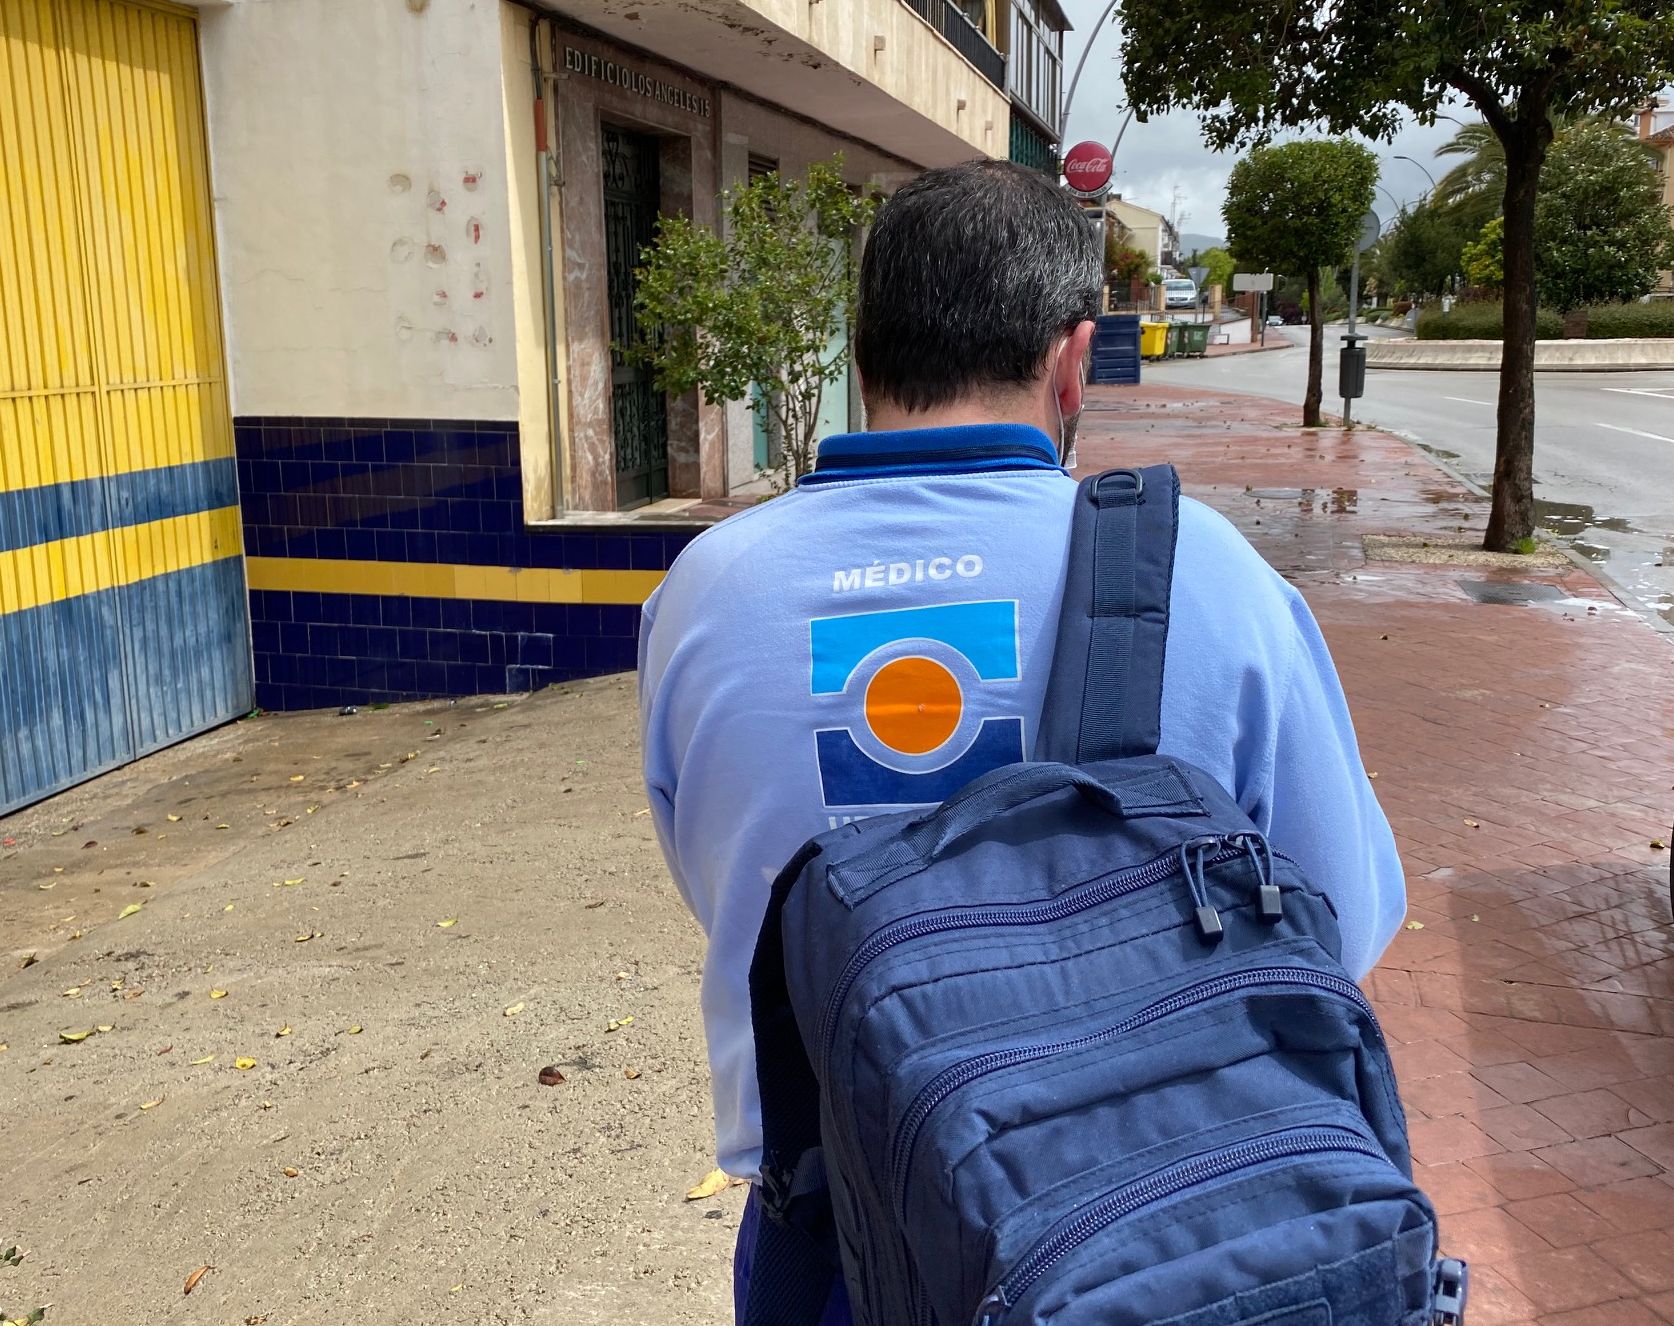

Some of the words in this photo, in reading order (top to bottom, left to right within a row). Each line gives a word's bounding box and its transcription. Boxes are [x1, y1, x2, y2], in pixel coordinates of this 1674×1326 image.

[565, 47, 630, 89] EDIFICIO
[631, 71, 652, 97] LOS
[654, 82, 698, 114] ANGELES
[832, 554, 984, 593] MÉDICO
